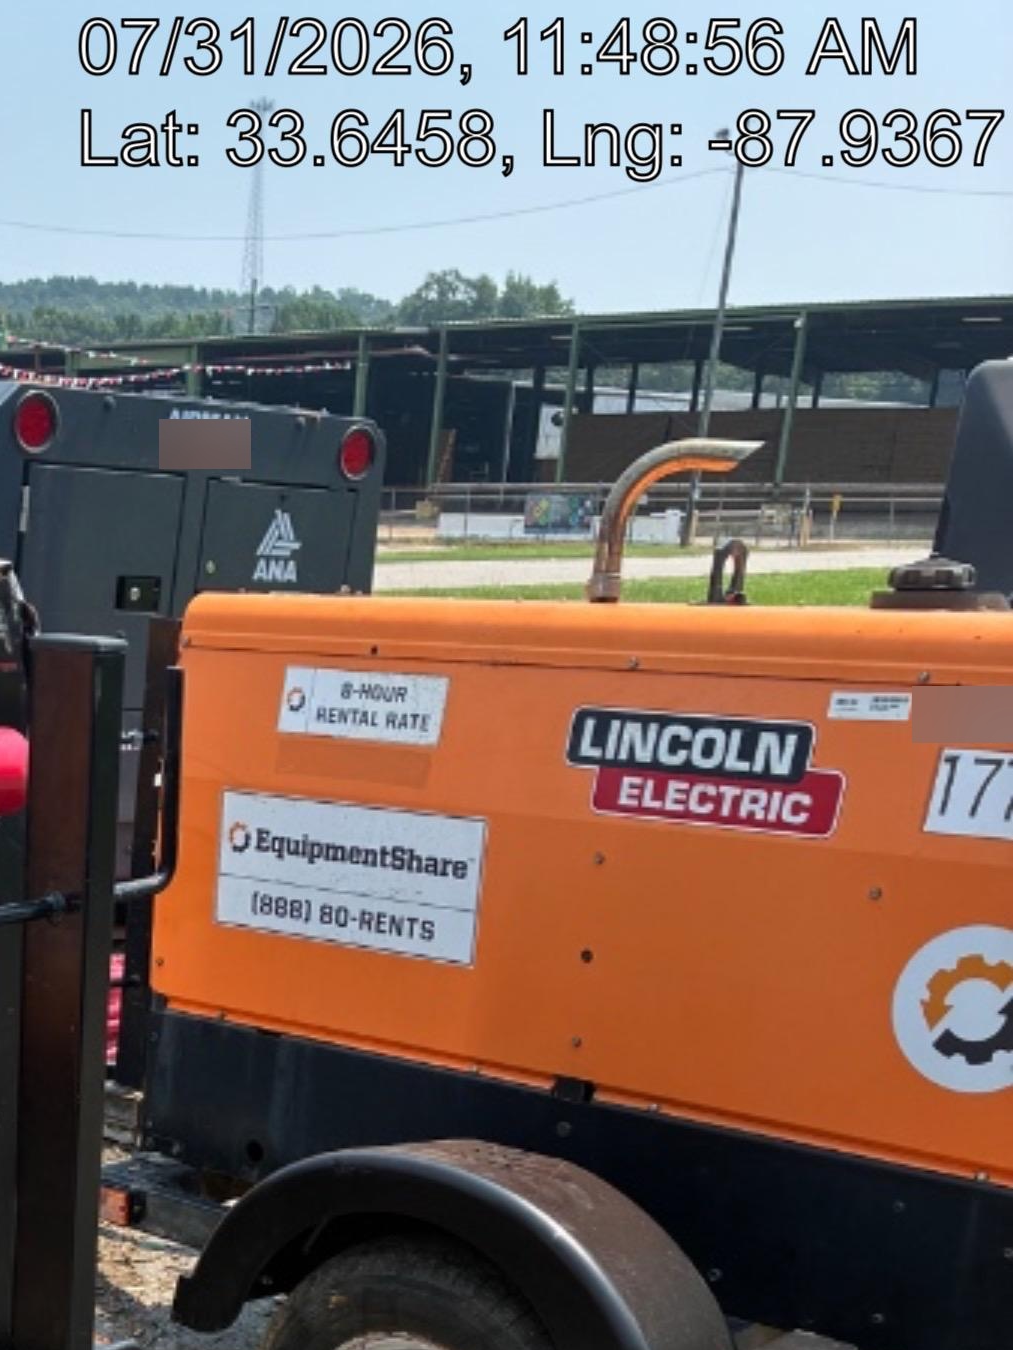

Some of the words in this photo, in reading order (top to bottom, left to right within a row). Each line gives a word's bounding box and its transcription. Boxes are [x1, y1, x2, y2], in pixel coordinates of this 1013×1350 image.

[252, 559, 298, 582] ANA
[340, 681, 408, 702] 8-HOUR
[316, 706, 378, 728] RENTAL
[386, 711, 431, 732] RATE
[578, 717, 798, 776] LINCOLN
[618, 776, 812, 825] ELECTRIC
[939, 755, 1013, 822] 17
[255, 827, 469, 879] EquipmentShare
[251, 891, 312, 923] (888)
[319, 904, 435, 941] 80-RENTS
